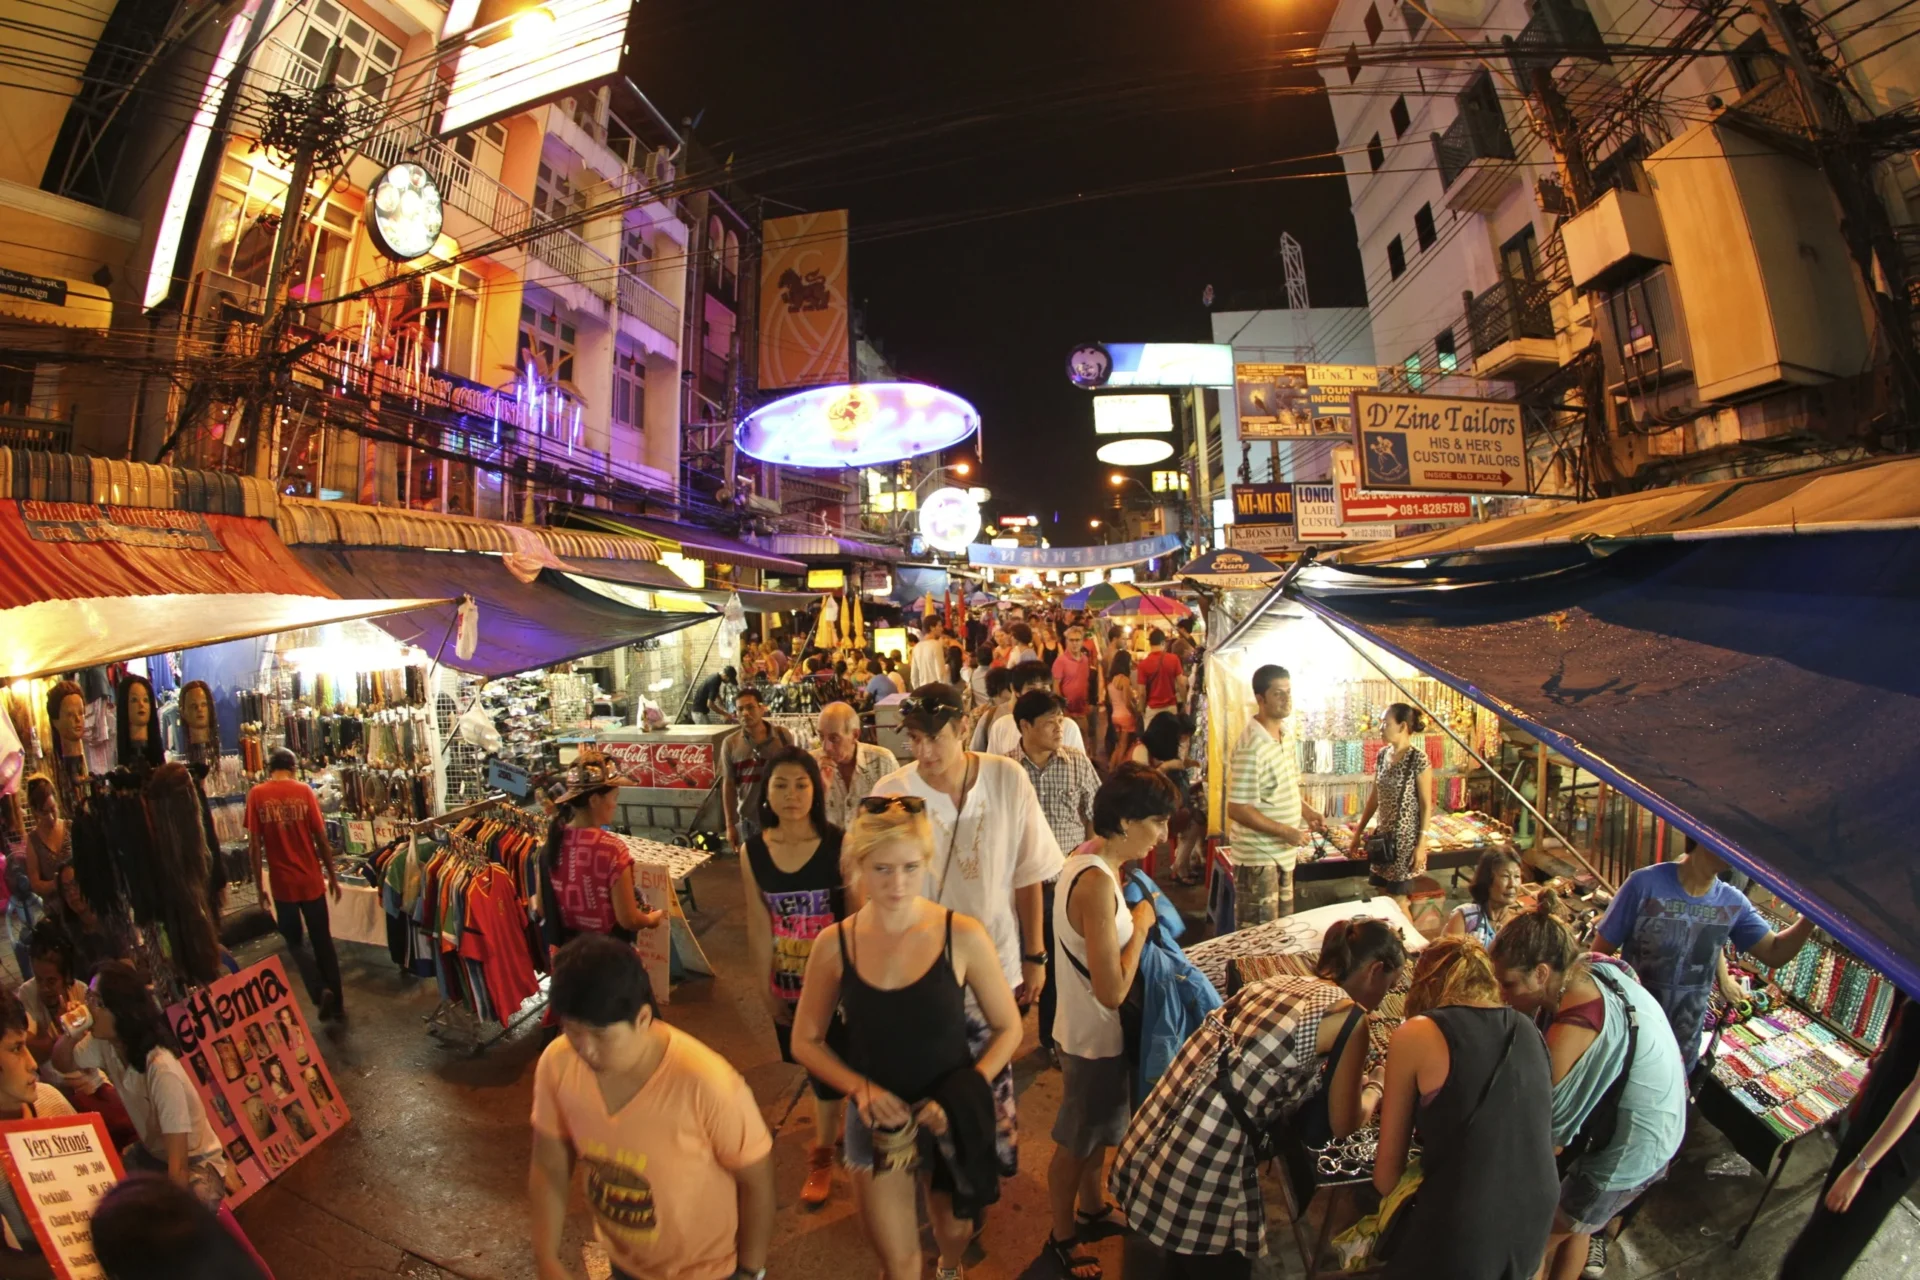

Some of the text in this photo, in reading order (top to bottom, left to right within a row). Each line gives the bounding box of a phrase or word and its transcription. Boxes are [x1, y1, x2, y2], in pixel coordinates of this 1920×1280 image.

[1367, 402, 1515, 436] D'Zine Tailors
[1429, 437, 1503, 452] HIS & HER'S
[1413, 450, 1521, 467] CUSTOM TAILORS
[1425, 470, 1452, 480] INSIDE
[1476, 473, 1501, 482] PLAZA
[1237, 492, 1273, 515] MI-MI
[1400, 502, 1466, 516] 081-8285789
[1234, 527, 1272, 540] K.BOSS
[1210, 562, 1250, 571] Chang
[1665, 900, 1687, 914] LET
[1703, 906, 1717, 919] BE
[23, 1131, 93, 1159] Very Strong
[28, 1160, 106, 1185] Bucket 200 300
[38, 1188, 73, 1207] Cocktails
[87, 1183, 99, 1197] 80
[49, 1208, 91, 1229] Chang Beer
[72, 1230, 93, 1244] Beer
